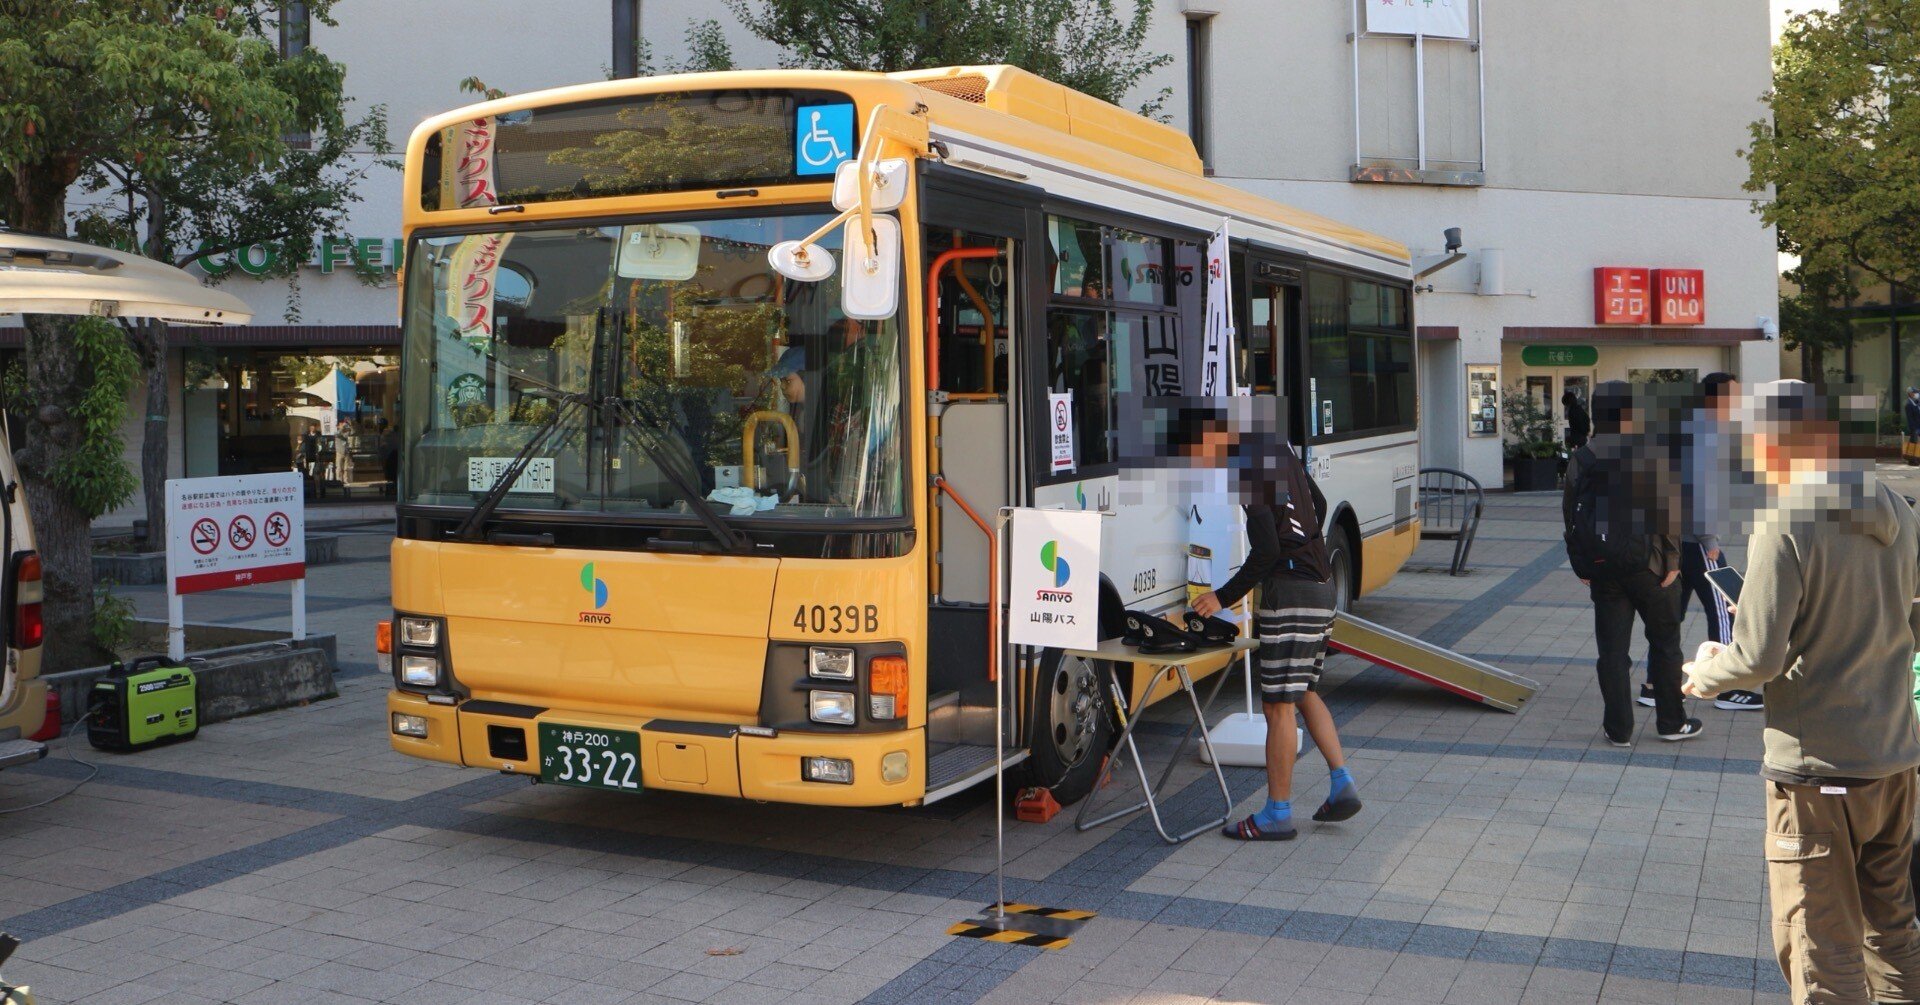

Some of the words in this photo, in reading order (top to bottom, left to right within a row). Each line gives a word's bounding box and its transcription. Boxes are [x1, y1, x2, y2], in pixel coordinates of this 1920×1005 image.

[197, 237, 403, 275] COFE
[1610, 274, 1643, 293] ユニ
[1665, 276, 1696, 295] UNI
[1610, 297, 1643, 316] クロ
[1665, 298, 1699, 320] QLO
[234, 572, 253, 582] 神戸市
[1133, 568, 1157, 595] 4039B
[1036, 589, 1074, 604] SANYO
[578, 611, 612, 625] SANYO
[793, 604, 879, 634] 4039B
[1030, 611, 1077, 626] 山陽バス
